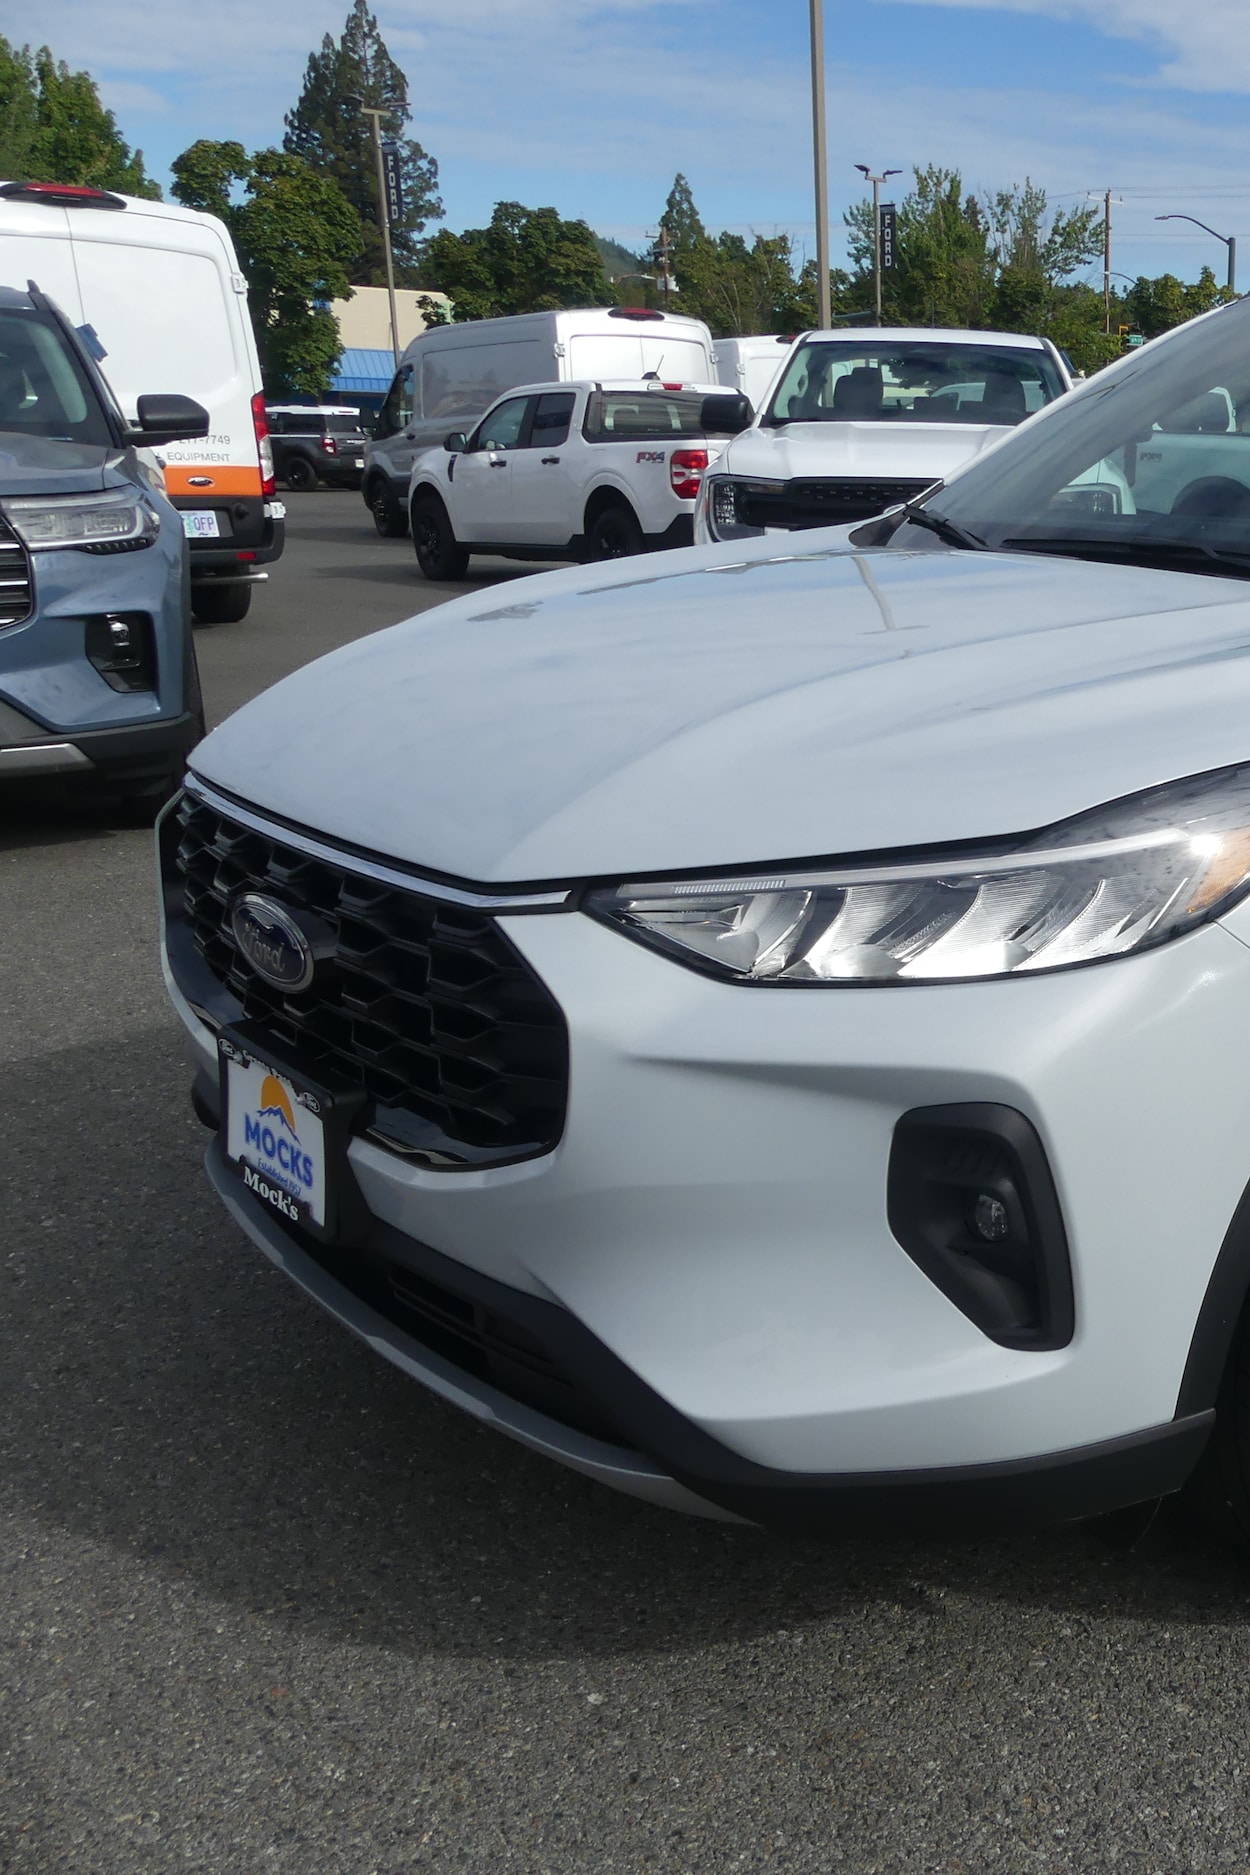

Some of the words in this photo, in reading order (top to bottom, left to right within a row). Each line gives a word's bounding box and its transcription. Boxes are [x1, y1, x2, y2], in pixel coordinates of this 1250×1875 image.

[387, 155, 399, 220] FORD
[884, 215, 892, 267] FORD
[167, 452, 231, 462] EQUIPMENT
[636, 451, 665, 463] FX4
[245, 1112, 313, 1188] MOCKS
[243, 1166, 299, 1221] Mock's
